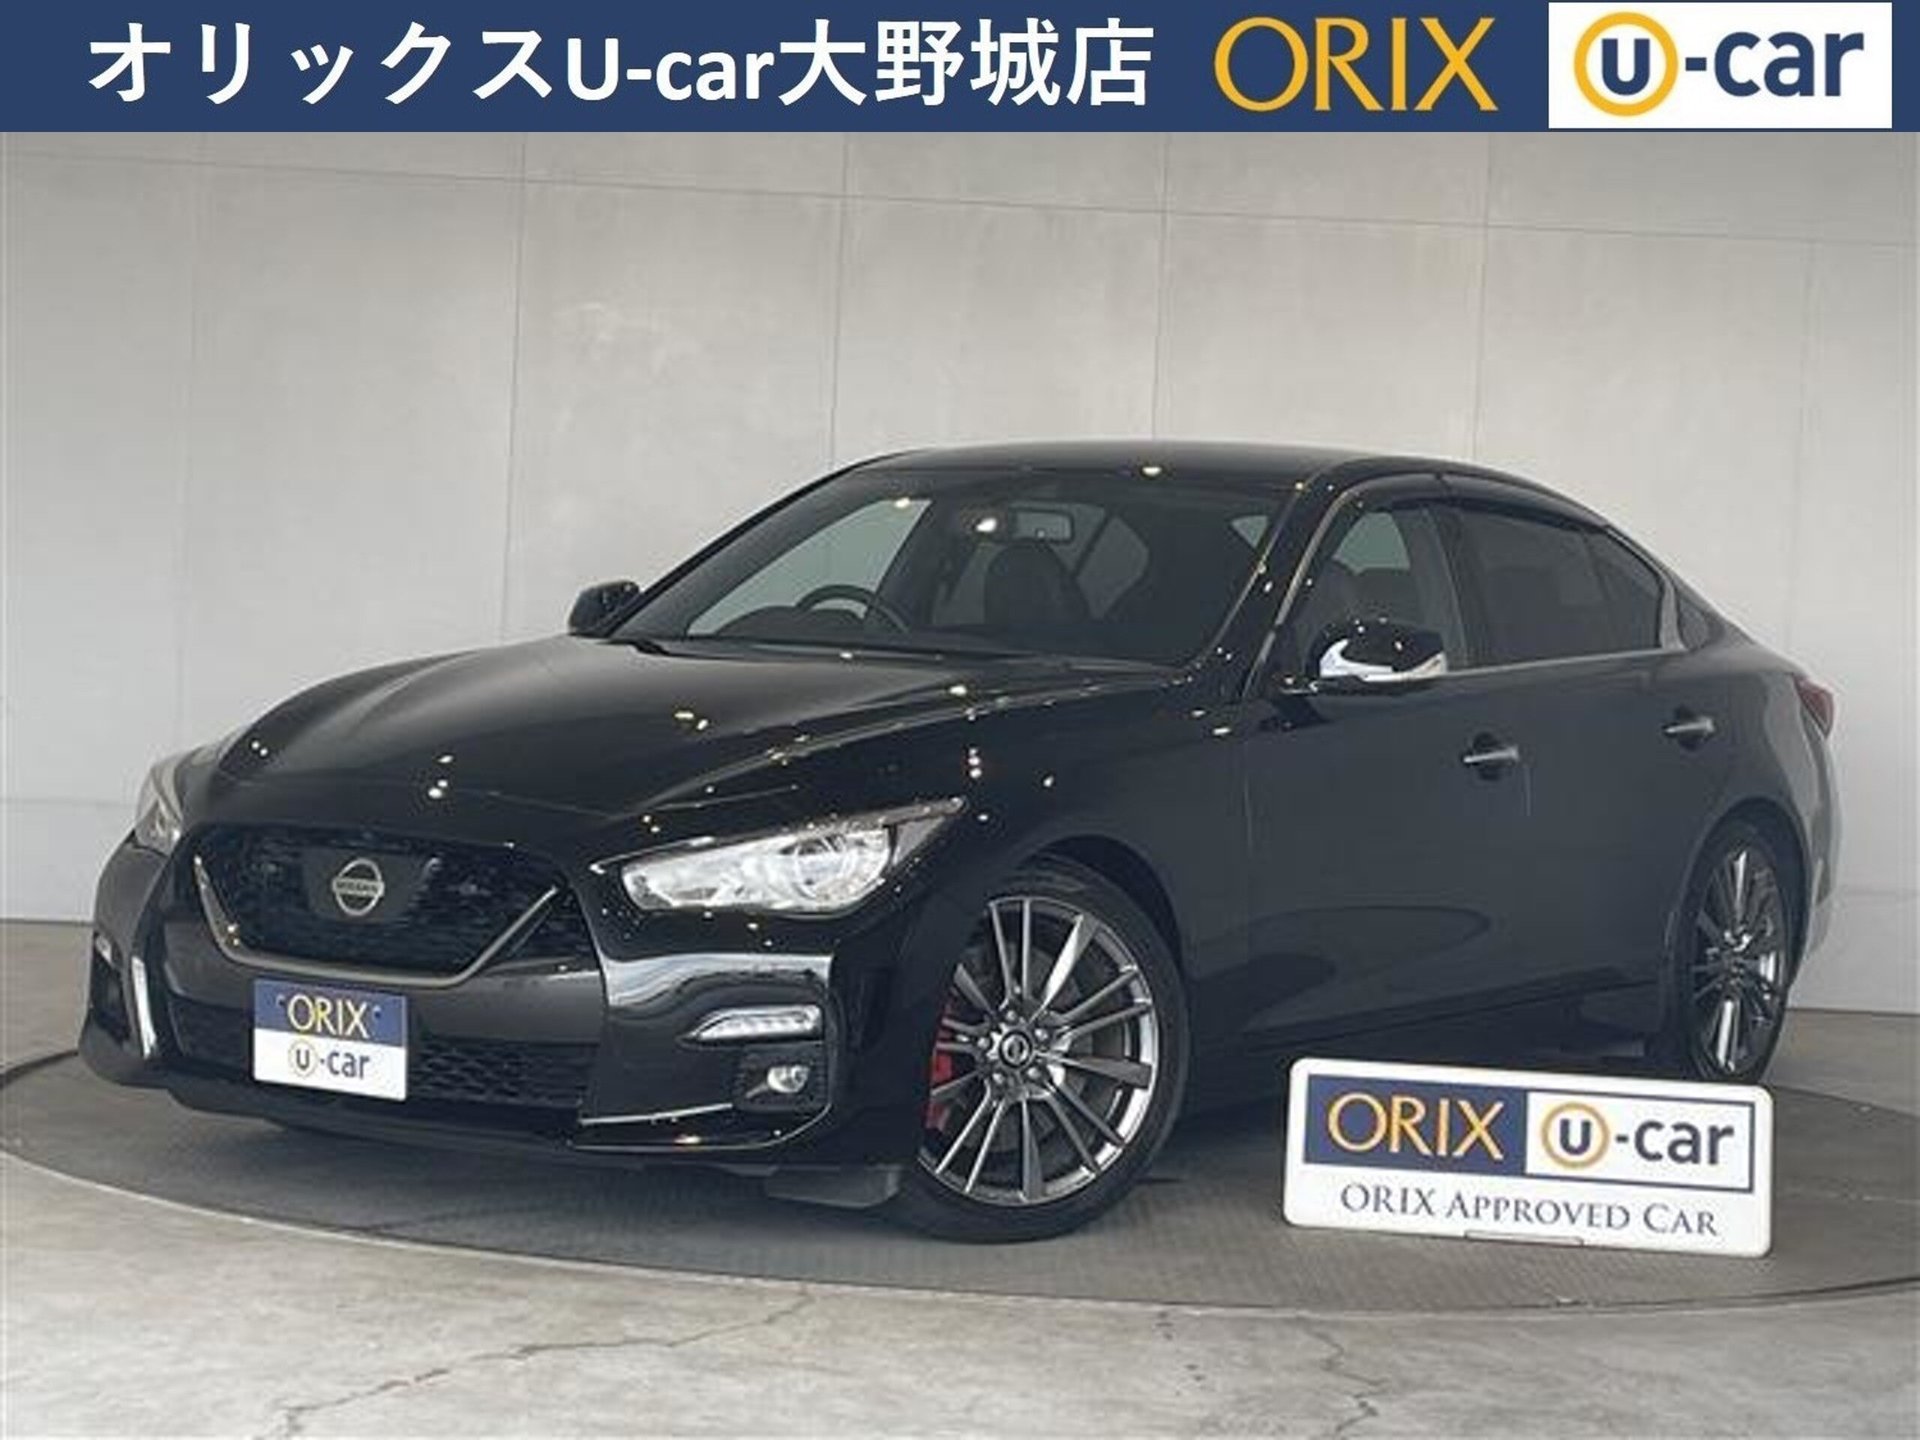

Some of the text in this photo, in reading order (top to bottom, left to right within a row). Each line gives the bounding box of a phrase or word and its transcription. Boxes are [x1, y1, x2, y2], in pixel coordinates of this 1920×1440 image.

[287, 994, 369, 1039] ORIX
[1328, 1092, 1504, 1161] ORIX
[1341, 1182, 1436, 1216] ORIX
